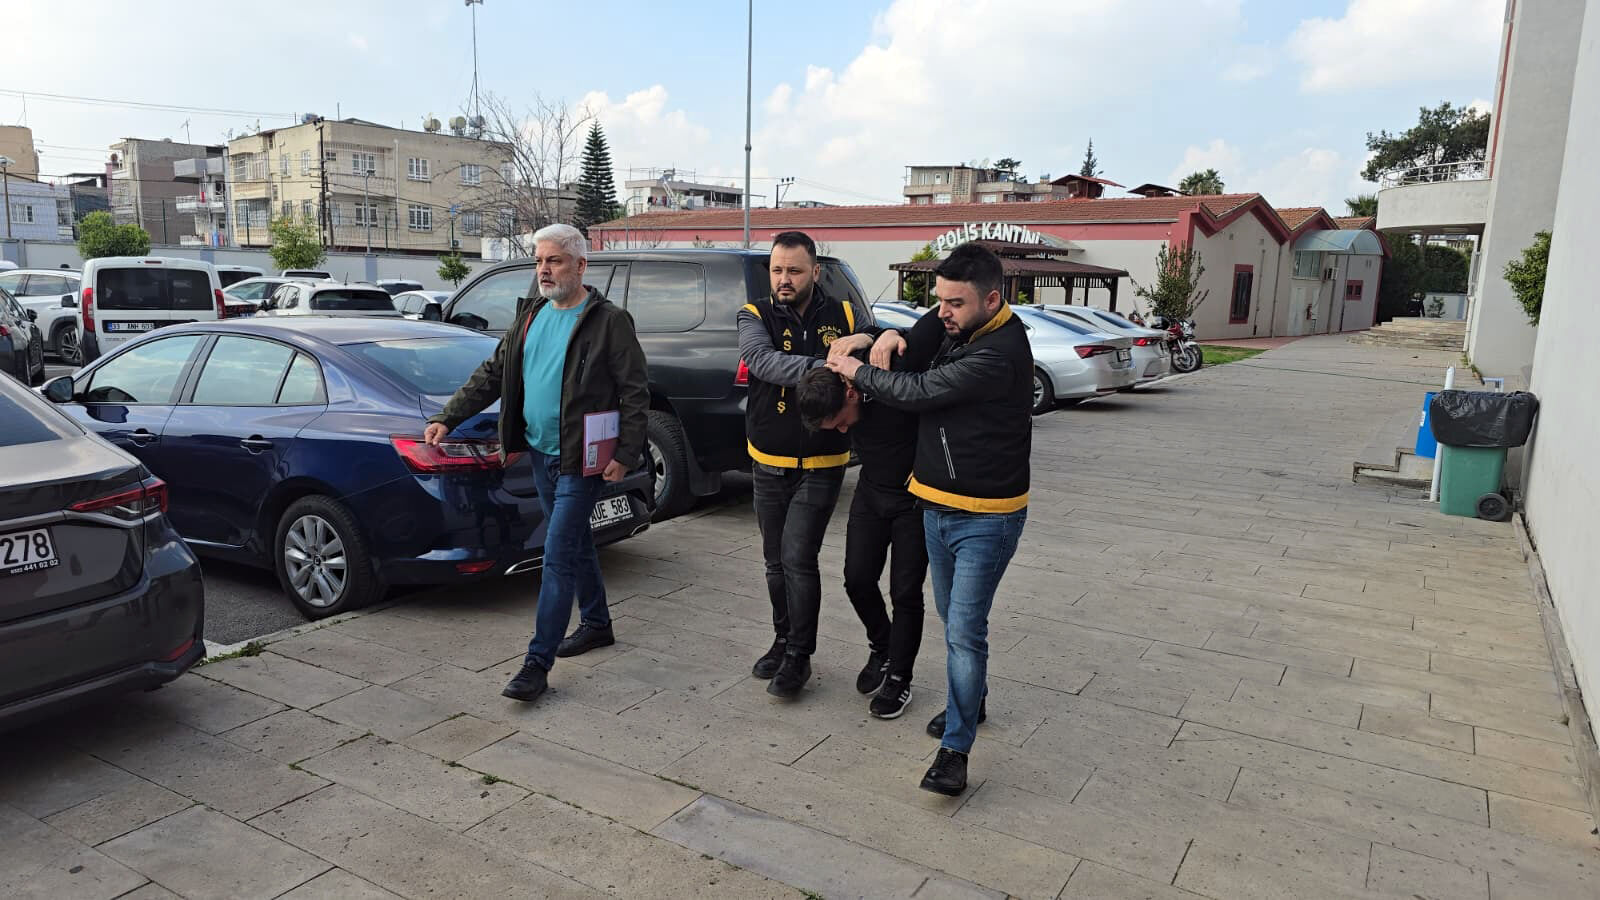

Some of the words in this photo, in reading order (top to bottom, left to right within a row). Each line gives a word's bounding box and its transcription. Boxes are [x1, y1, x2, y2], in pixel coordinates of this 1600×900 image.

[936, 222, 978, 253] POLİS
[981, 222, 1041, 245] KANTİNİ
[610, 497, 629, 515] 583
[0, 533, 50, 565] 278
